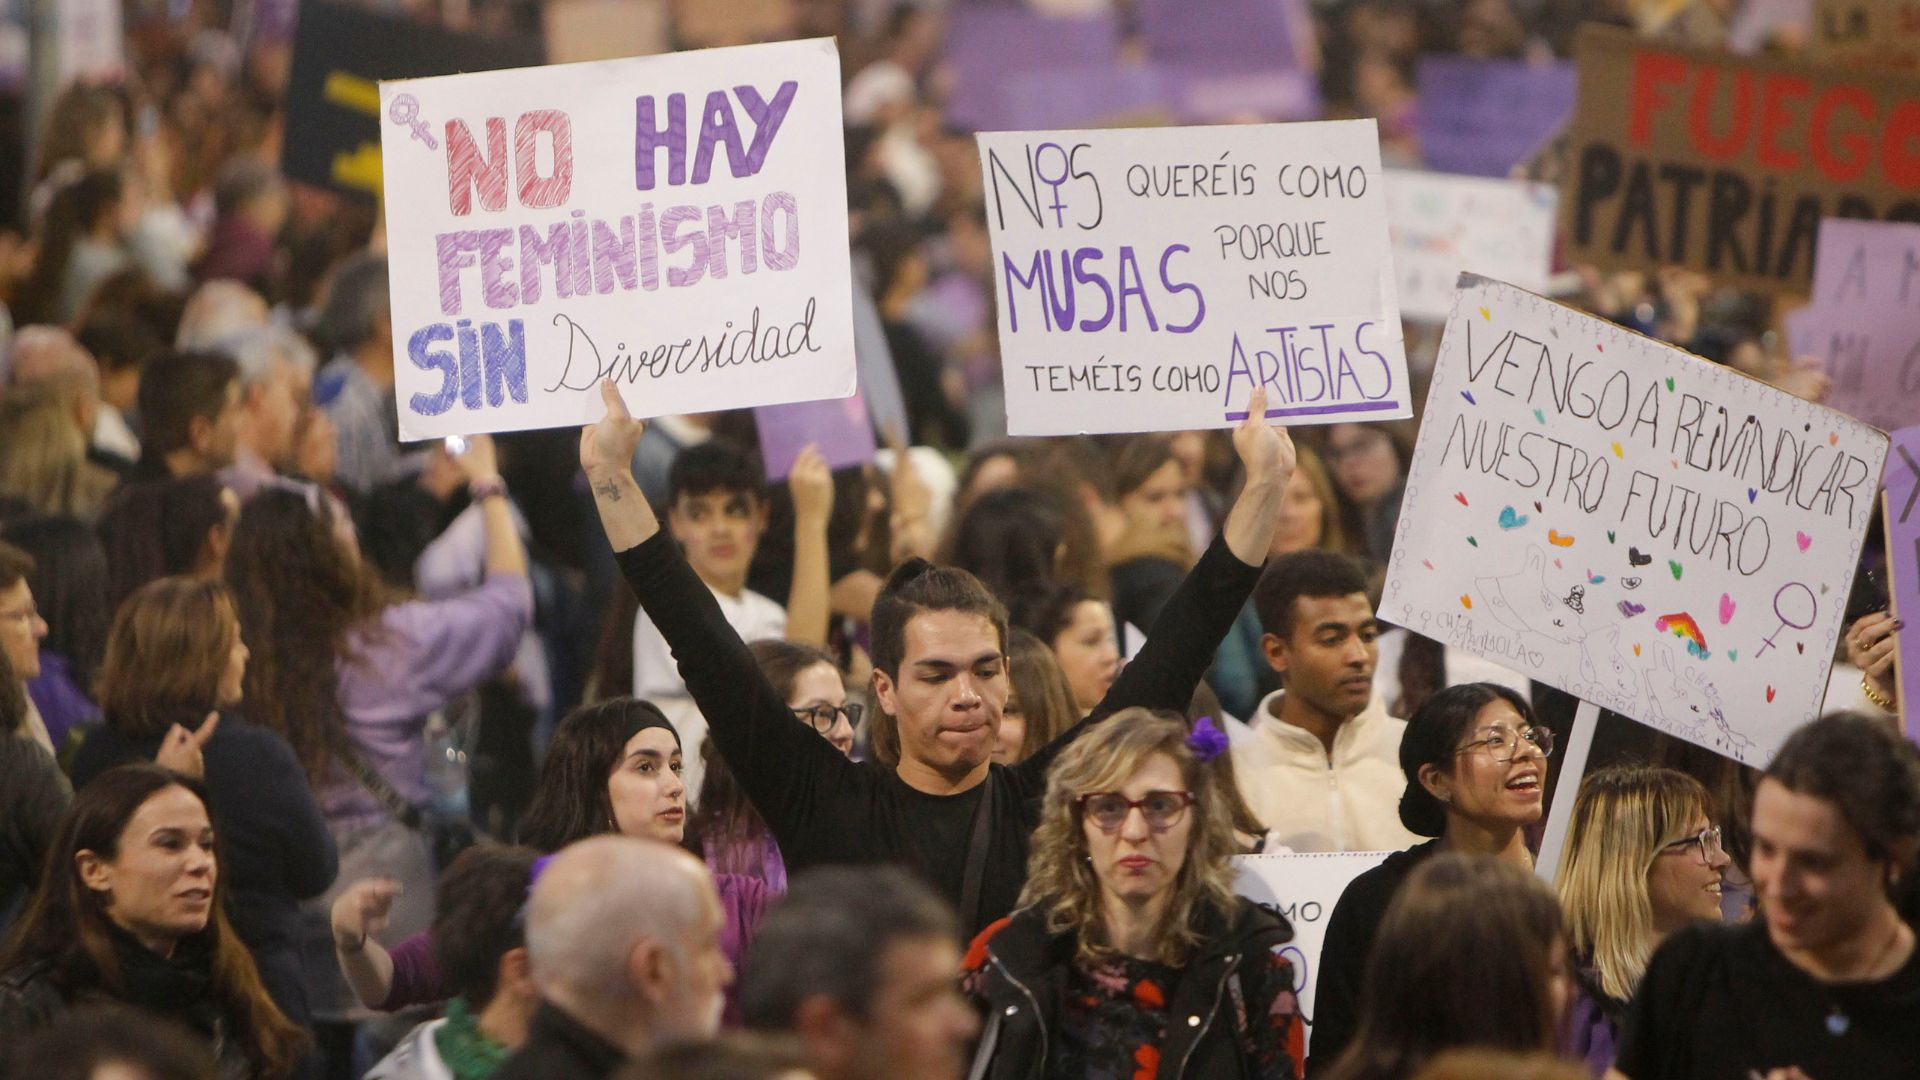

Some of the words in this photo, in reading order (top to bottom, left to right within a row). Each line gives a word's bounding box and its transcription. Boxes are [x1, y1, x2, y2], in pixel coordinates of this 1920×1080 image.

[444, 109, 573, 216] NO
[635, 80, 799, 191] HAY
[1126, 151, 1257, 199] QUERÉIS
[1278, 164, 1368, 199] COMO
[1214, 220, 1331, 262] PORQUE
[1249, 269, 1308, 301] NOS
[1002, 243, 1206, 334] MUSAS
[407, 318, 528, 416] SIN
[544, 296, 822, 393] Diversidad
[1025, 355, 1142, 393] TEMÉIS
[1152, 365, 1221, 394] COMO
[1224, 321, 1393, 408] ARTISTAS
[1440, 413, 1610, 514] NUESTRO
[1620, 470, 1771, 576] FUTURO
